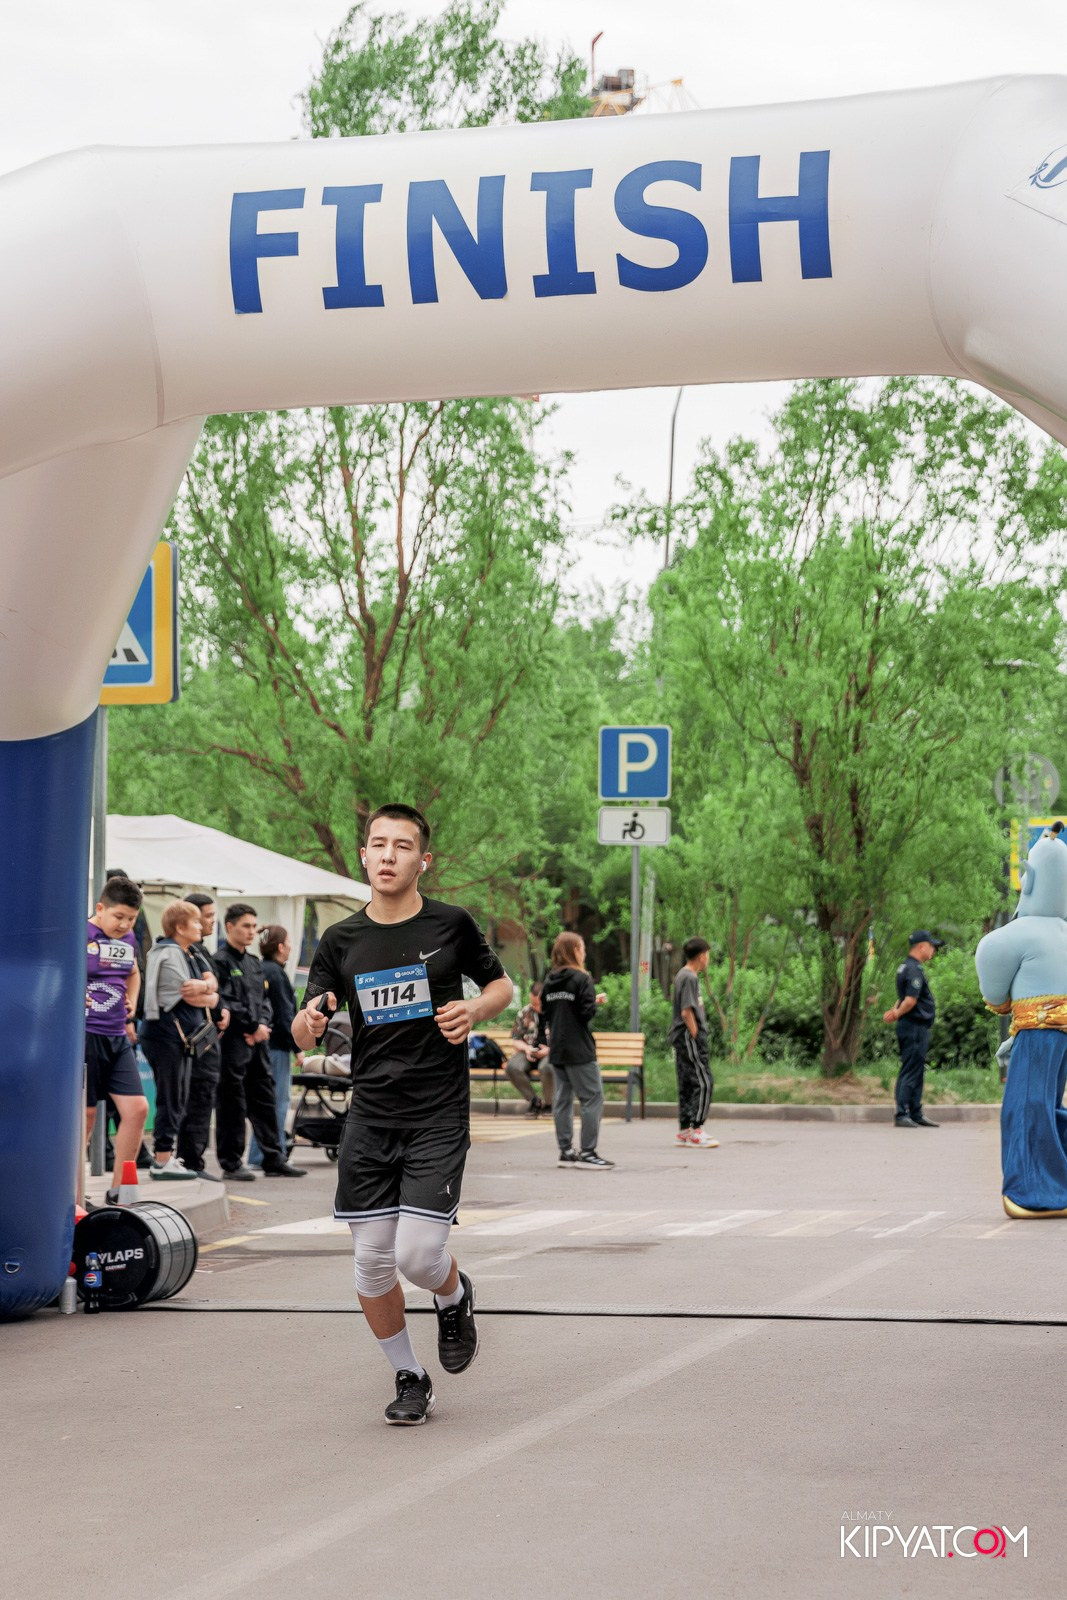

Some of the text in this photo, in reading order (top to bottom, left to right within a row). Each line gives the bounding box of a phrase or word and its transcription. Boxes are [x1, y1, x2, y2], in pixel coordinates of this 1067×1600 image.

[229, 150, 832, 314] FINISH
[618, 732, 658, 794] P
[109, 947, 126, 959] 129
[371, 983, 416, 1007] 1114
